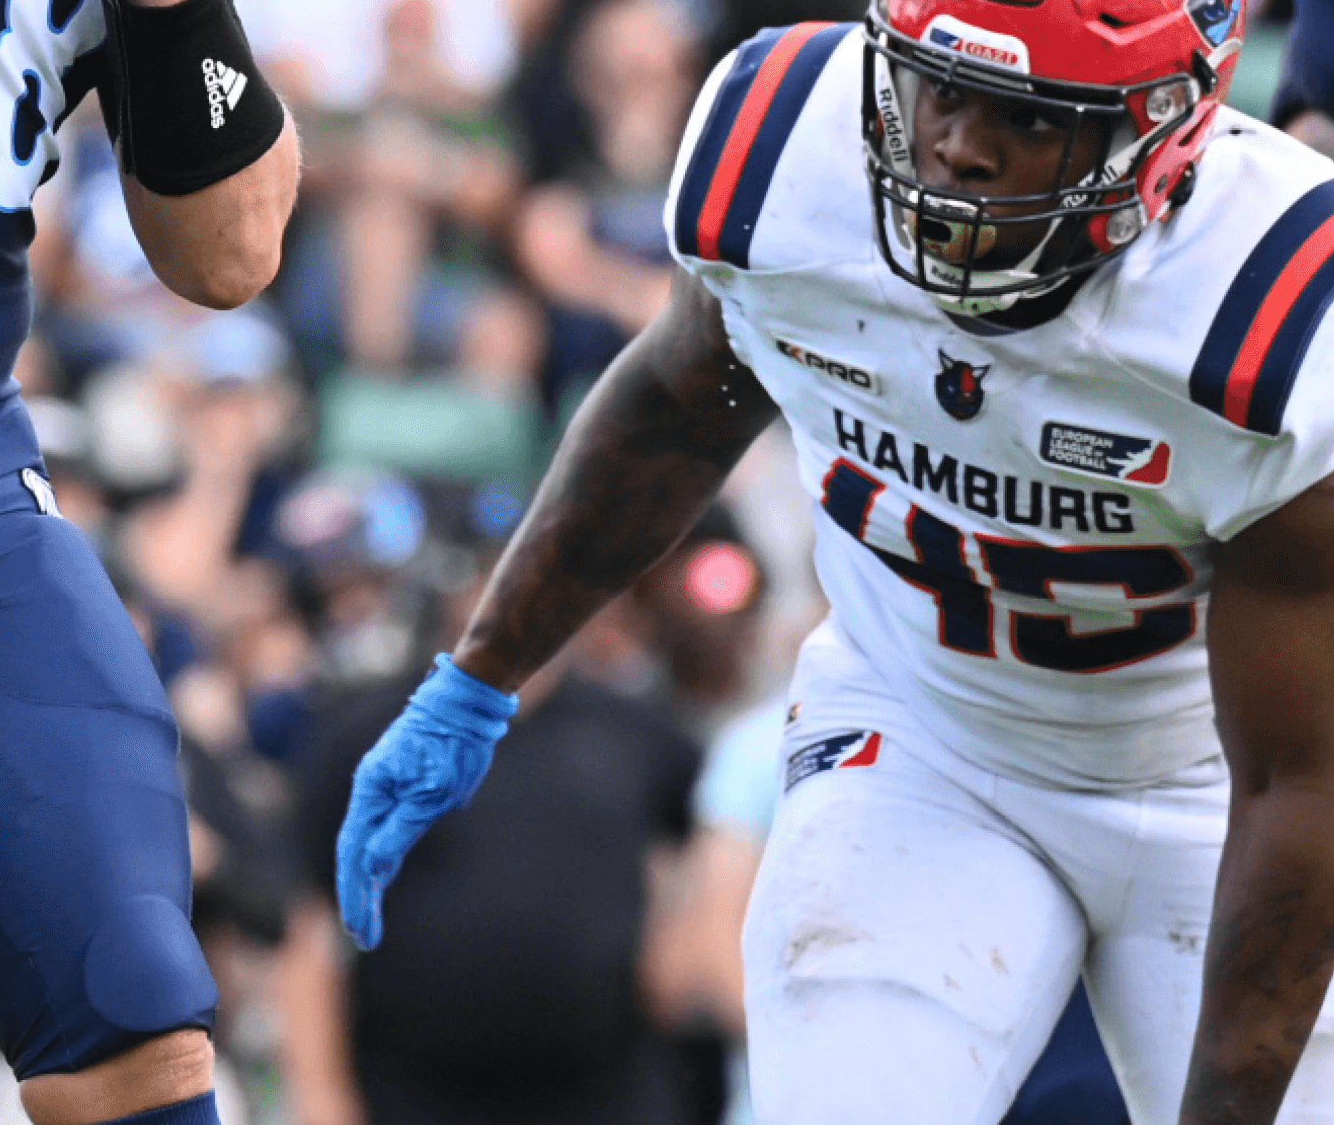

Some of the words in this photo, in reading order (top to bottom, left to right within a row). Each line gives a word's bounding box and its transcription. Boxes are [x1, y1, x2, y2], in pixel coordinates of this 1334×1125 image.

[201, 57, 227, 130] adidas
[879, 87, 909, 163] Riddell
[833, 407, 1135, 534] HAMBURG
[1051, 427, 1114, 449] EUROPEAN
